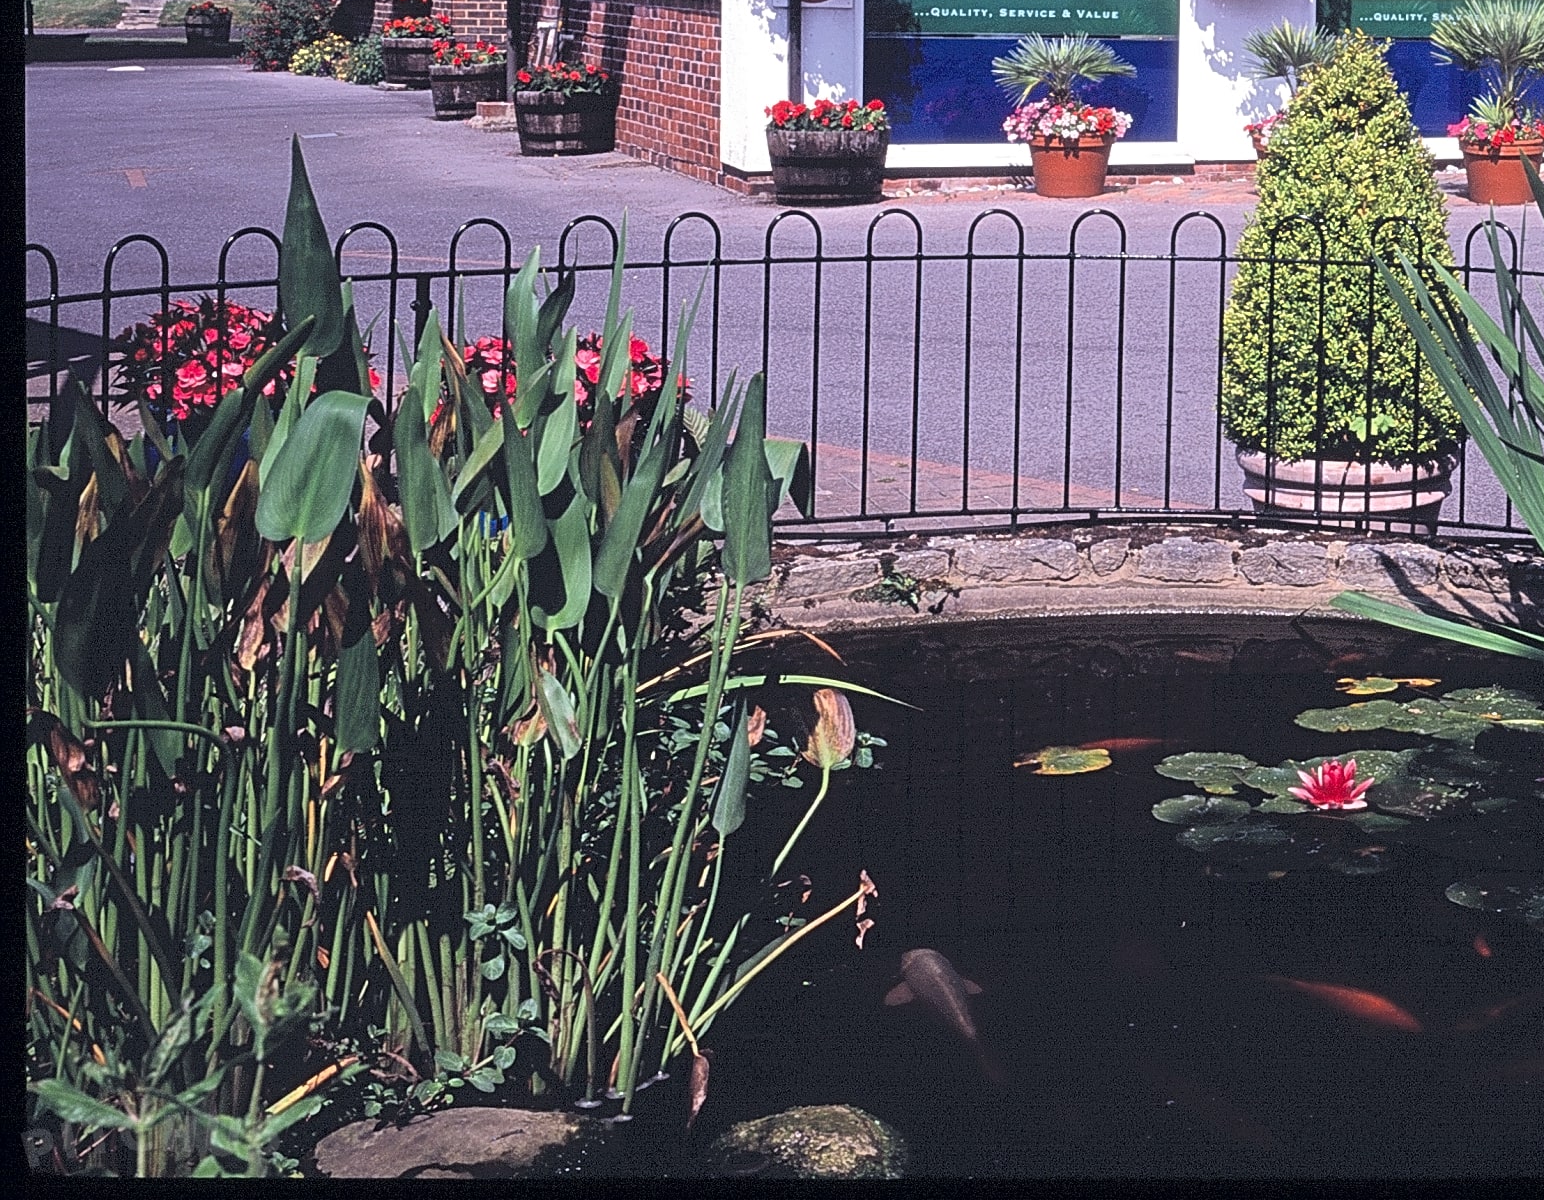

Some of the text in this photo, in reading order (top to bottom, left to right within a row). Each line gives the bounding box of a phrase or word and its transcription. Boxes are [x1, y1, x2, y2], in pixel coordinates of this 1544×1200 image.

[999, 8, 1057, 18] SERVICE
[1061, 10, 1071, 18] &
[1077, 9, 1119, 19] VALUE
